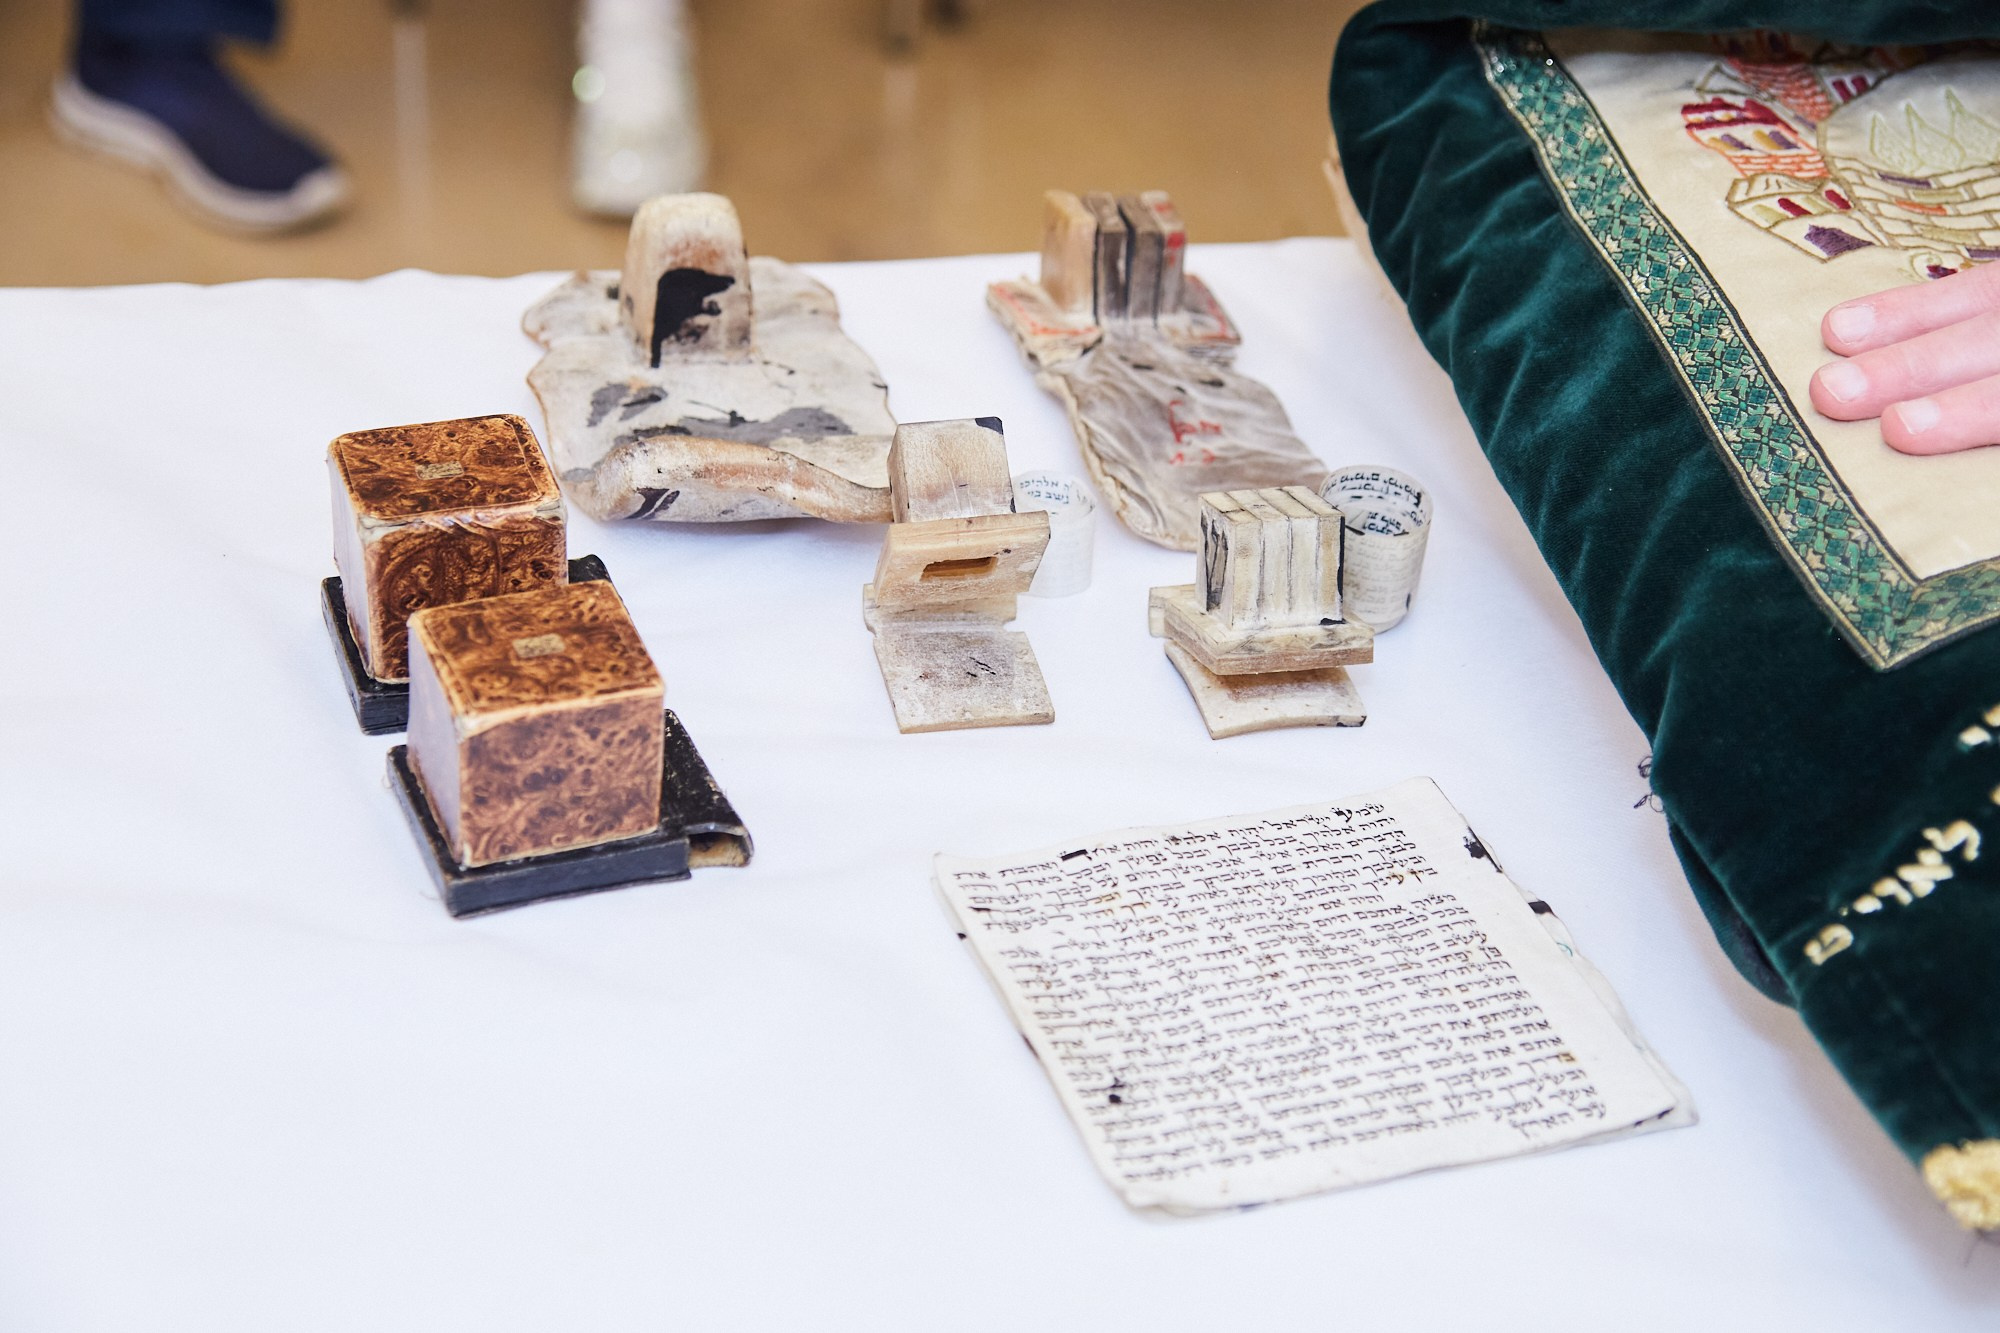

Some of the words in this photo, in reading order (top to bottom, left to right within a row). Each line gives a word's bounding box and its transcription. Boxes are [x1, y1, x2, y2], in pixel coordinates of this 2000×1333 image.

[1331, 803, 1384, 823] שמע
[1262, 814, 1331, 831] ישראל
[1358, 817, 1395, 831] יהוה
[1227, 826, 1265, 837] יהוה
[1302, 825, 1356, 842] אלהיך
[1347, 830, 1406, 848] הדברים
[1123, 840, 1159, 851] יהוה
[1217, 837, 1261, 856] לבבך
[1255, 834, 1297, 846] בכל
[1060, 845, 1121, 862] אחד
[1295, 841, 1345, 856] האלה
[1367, 839, 1416, 860] לבניך
[1118, 852, 1167, 870] נפשך
[1206, 857, 1245, 869] אנכי
[1271, 863, 1296, 875] בם
[1302, 853, 1363, 869] ודברת
[1362, 855, 1426, 876] ובשכבך
[1362, 872, 1404, 892] עיניך
[1407, 867, 1438, 883] בין
[1318, 899, 1345, 910] אם
[1410, 894, 1456, 908] מצוה
[1353, 905, 1407, 920] אתכם
[1478, 946, 1502, 960] פן
